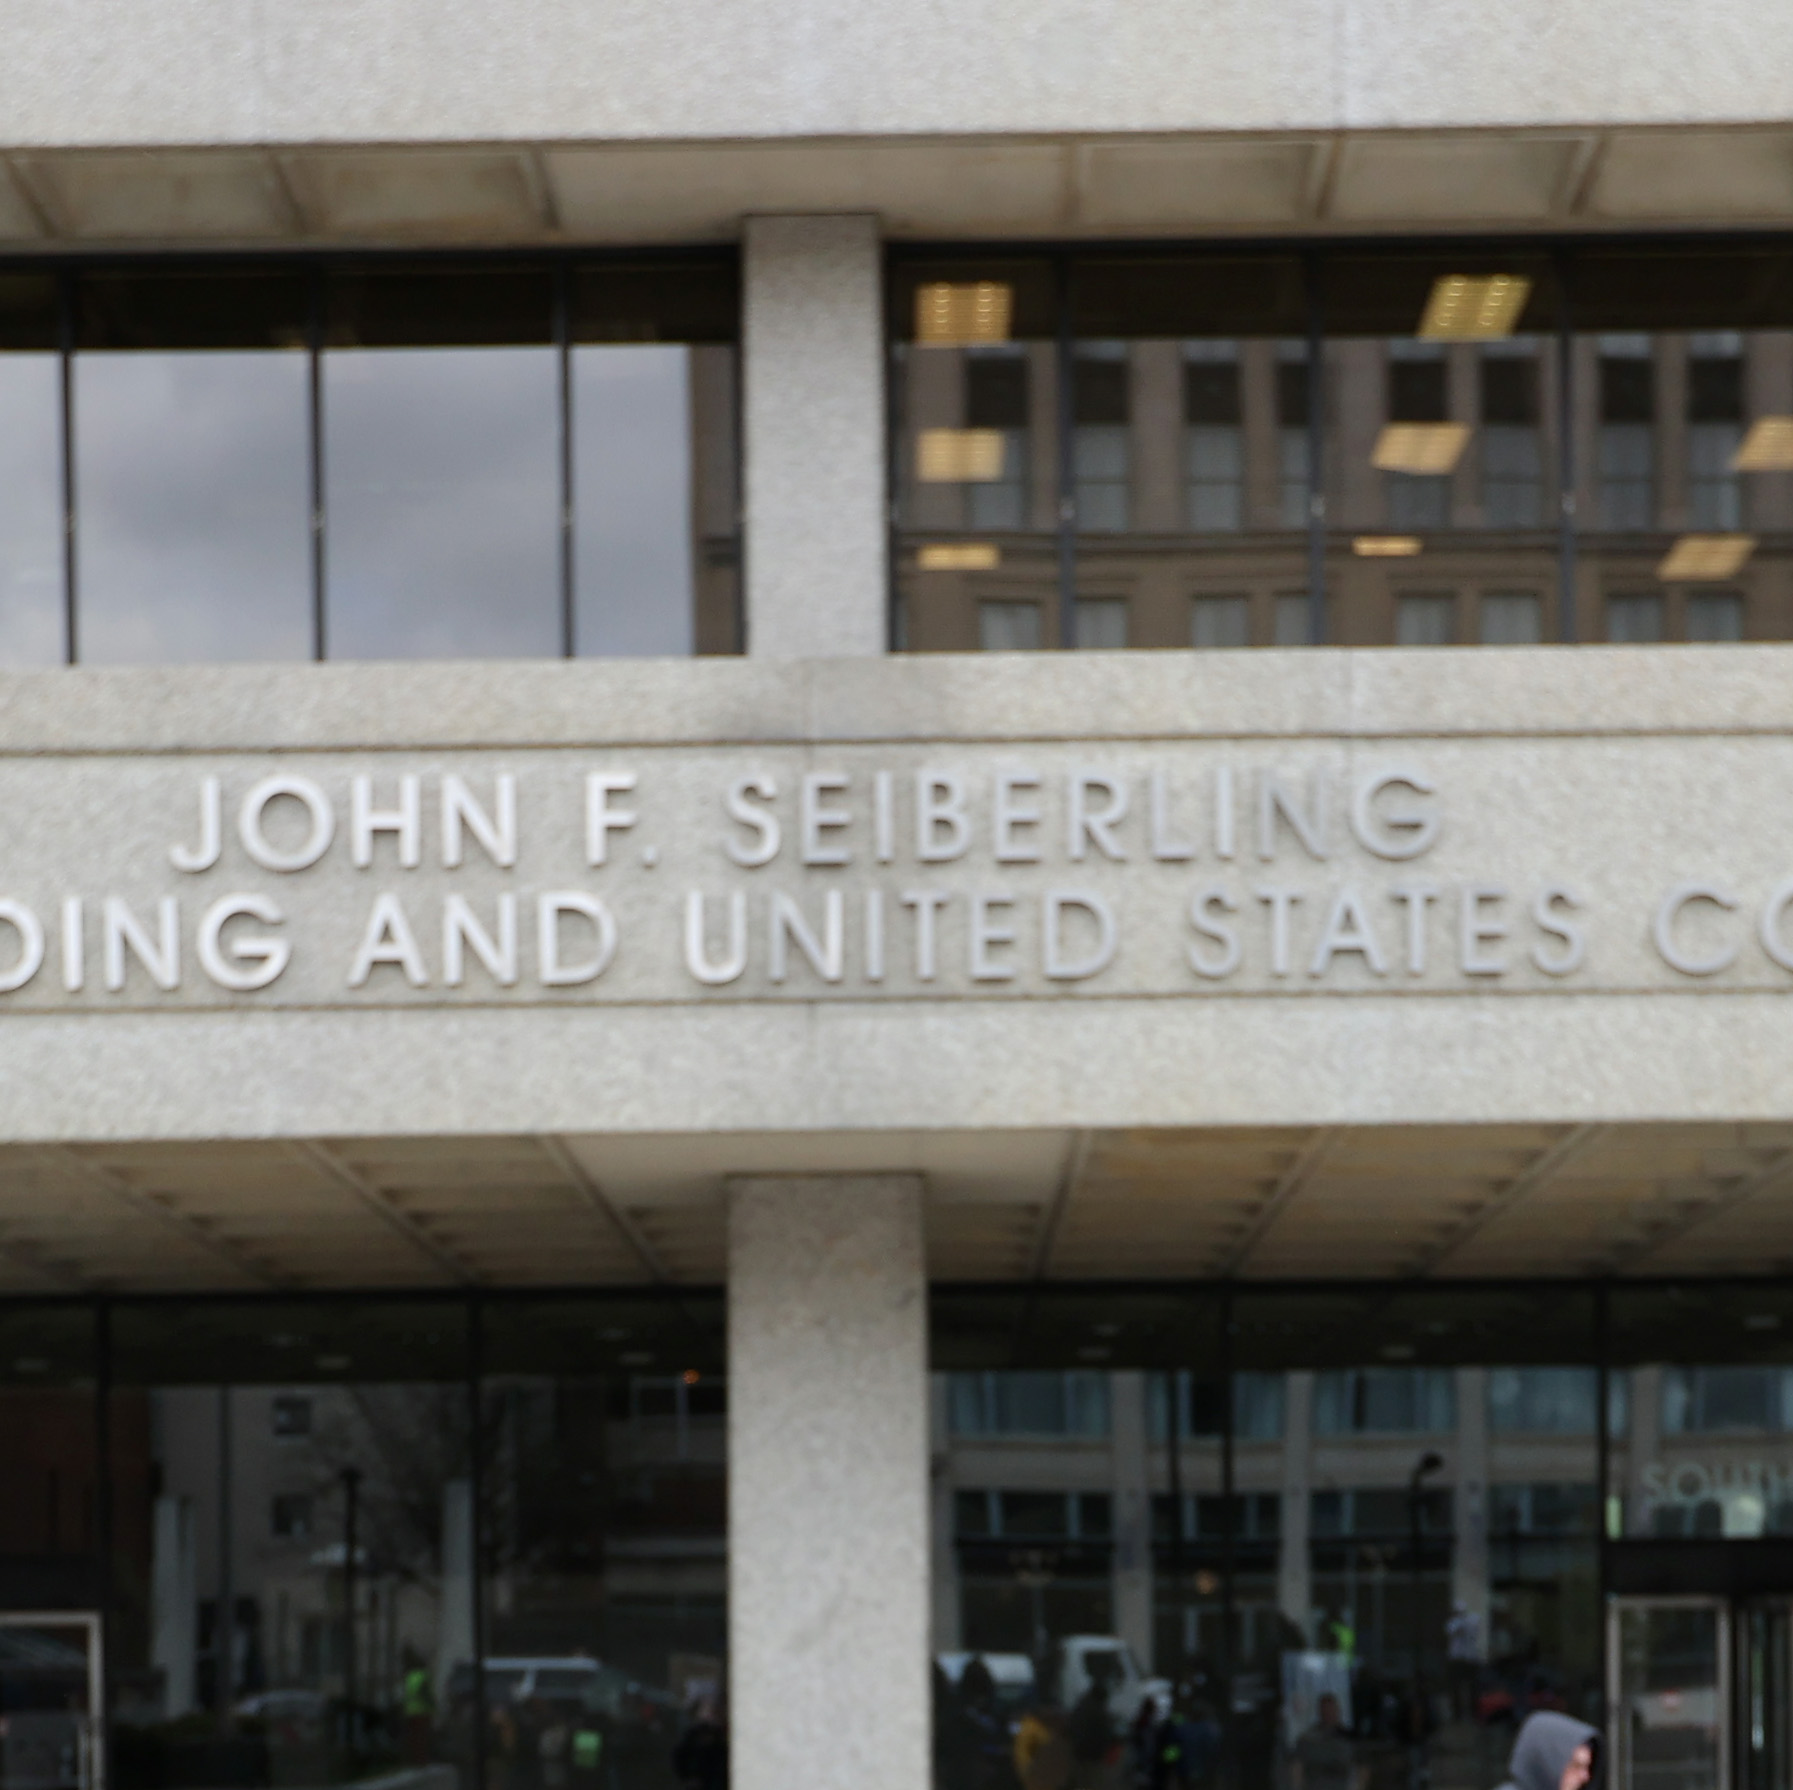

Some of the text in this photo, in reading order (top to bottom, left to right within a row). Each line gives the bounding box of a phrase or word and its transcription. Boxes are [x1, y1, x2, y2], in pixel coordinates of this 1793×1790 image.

[168, 763, 1441, 874] JOHN F. SEIBERLING
[346, 889, 617, 990] AND
[684, 886, 1118, 986] UNITED
[1188, 884, 1587, 979] STATES
